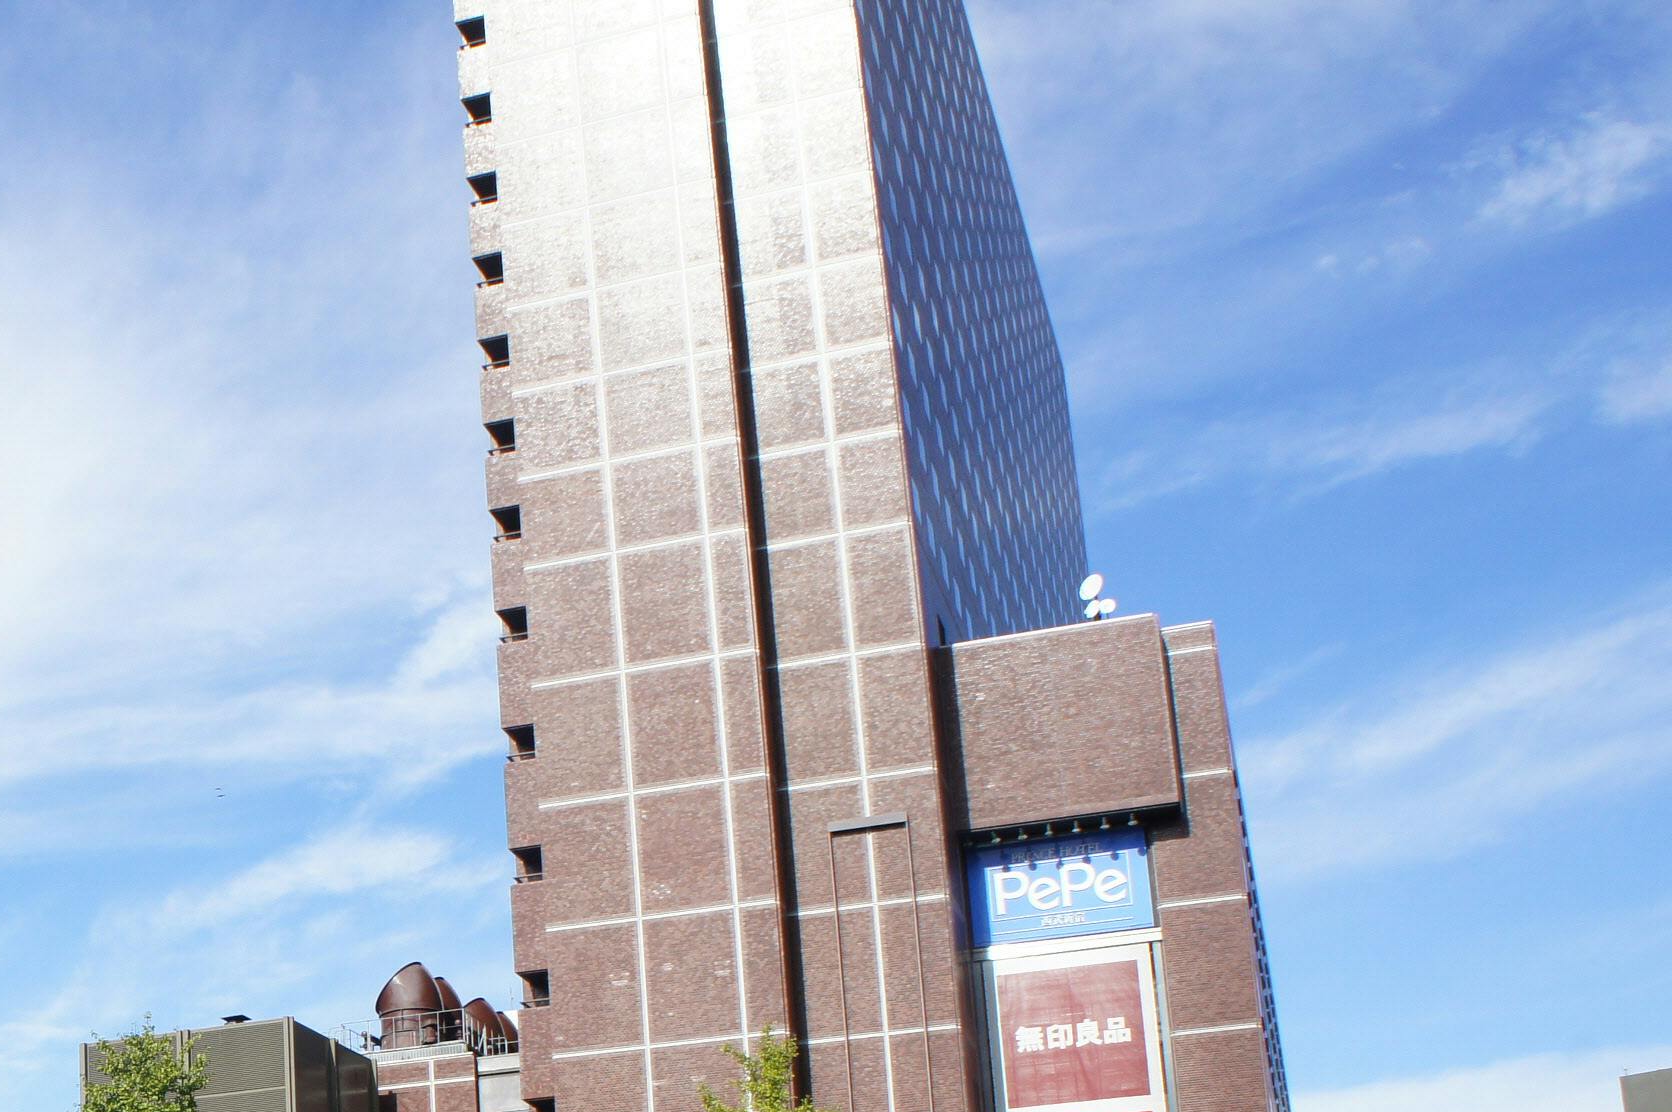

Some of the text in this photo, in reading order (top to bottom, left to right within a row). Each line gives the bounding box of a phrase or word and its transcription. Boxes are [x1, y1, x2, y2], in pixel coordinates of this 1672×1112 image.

[1059, 841, 1100, 857] HOTEL
[993, 861, 1128, 915] PePe
[1015, 1016, 1132, 1053] 無印良品
